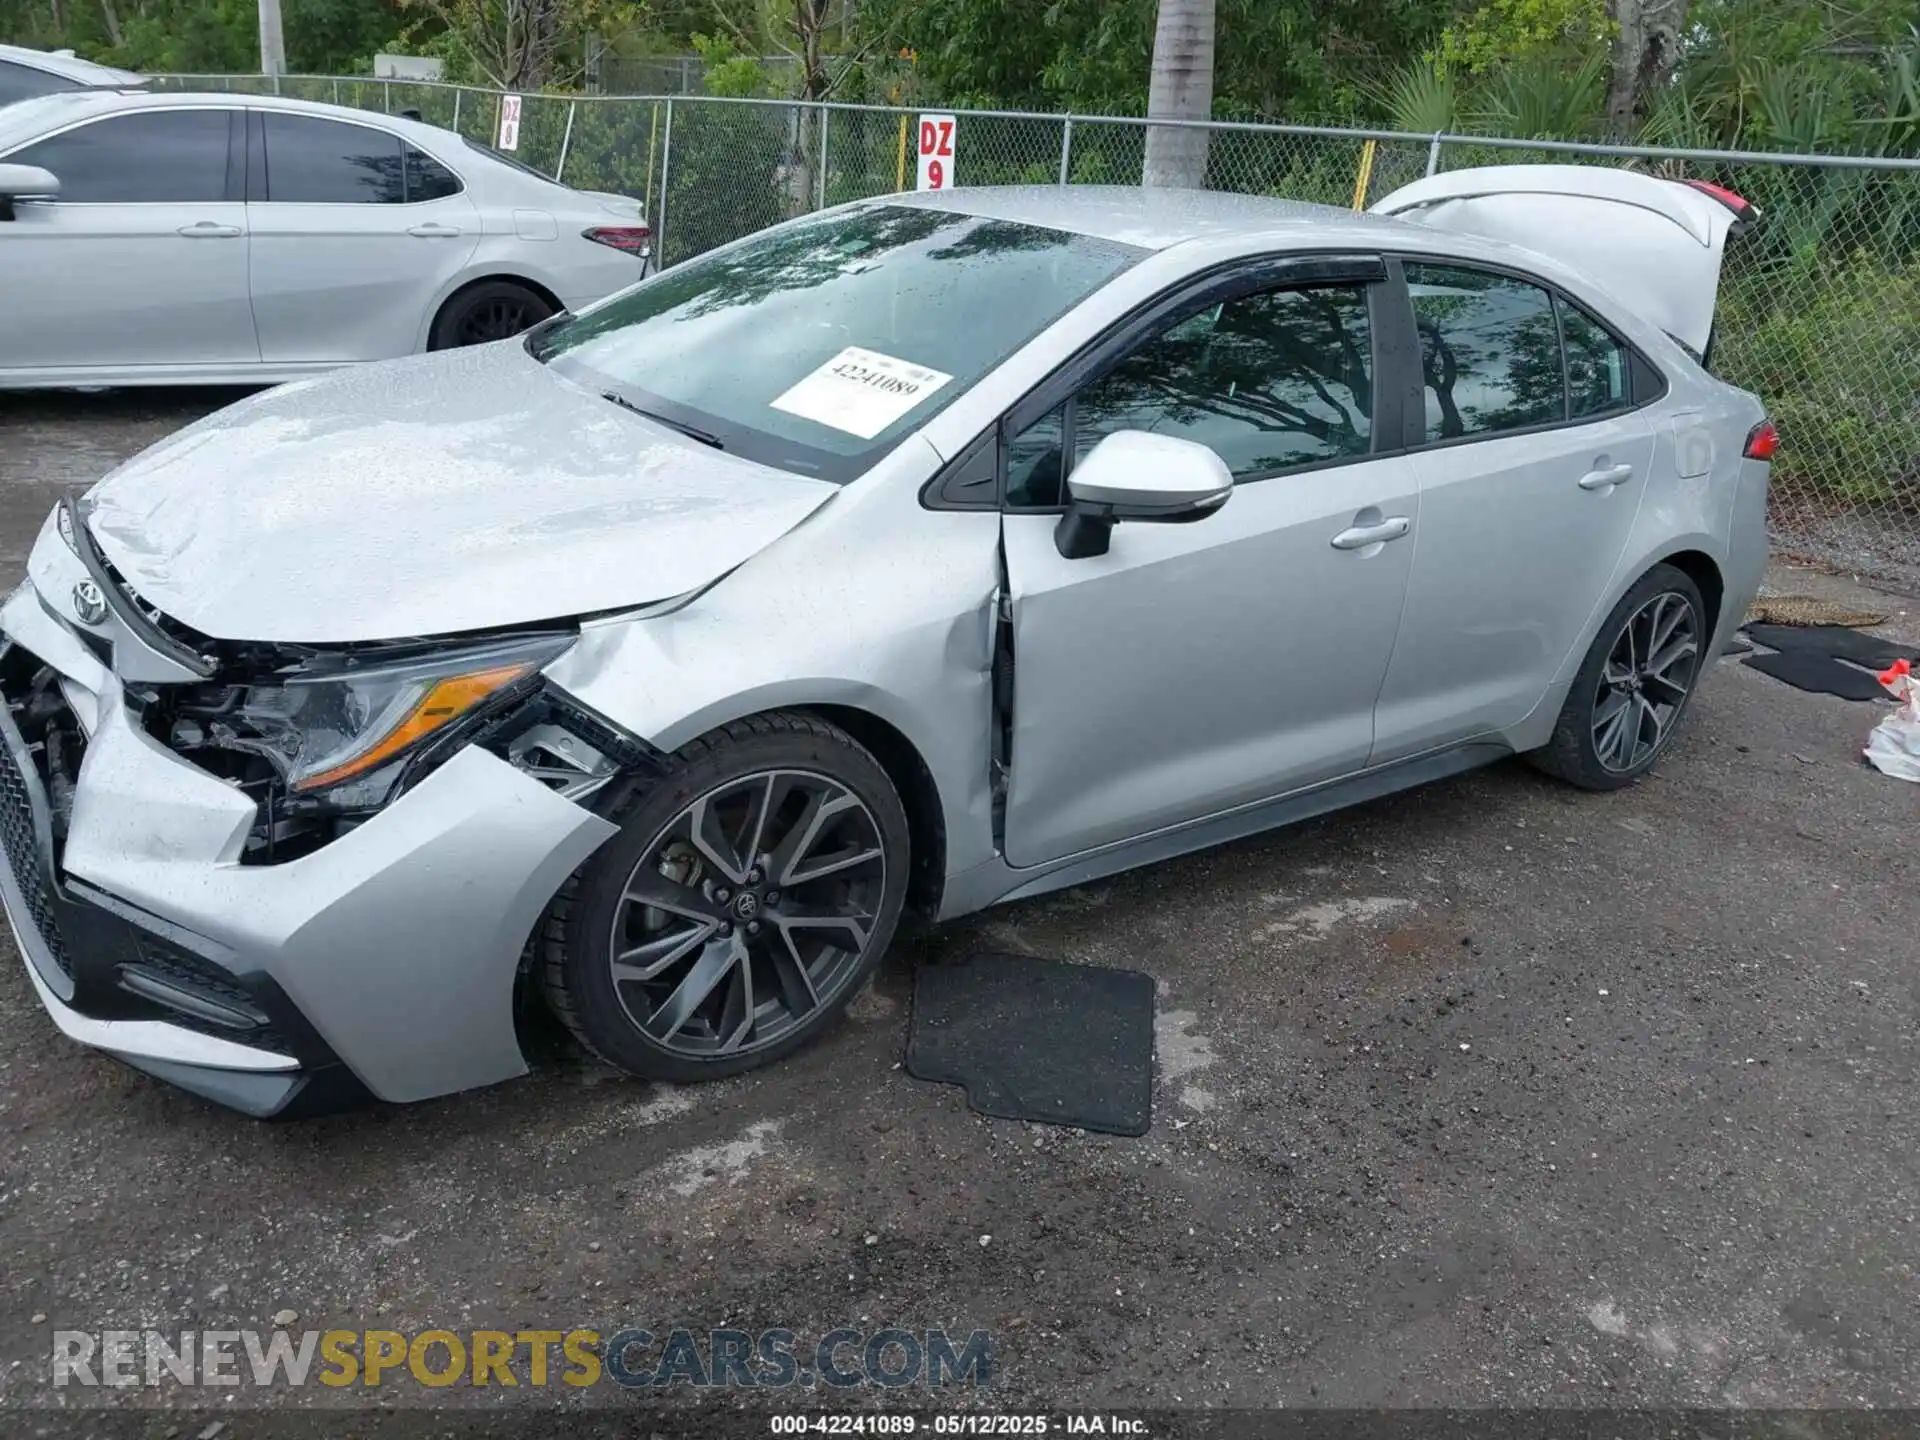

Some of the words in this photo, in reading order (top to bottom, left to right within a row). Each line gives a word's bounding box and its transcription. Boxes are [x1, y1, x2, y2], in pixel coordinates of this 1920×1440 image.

[503, 100, 520, 121] DZ
[505, 124, 512, 145] 8
[920, 121, 953, 156] DZ
[928, 160, 943, 190] 9
[832, 363, 920, 396] 42241089
